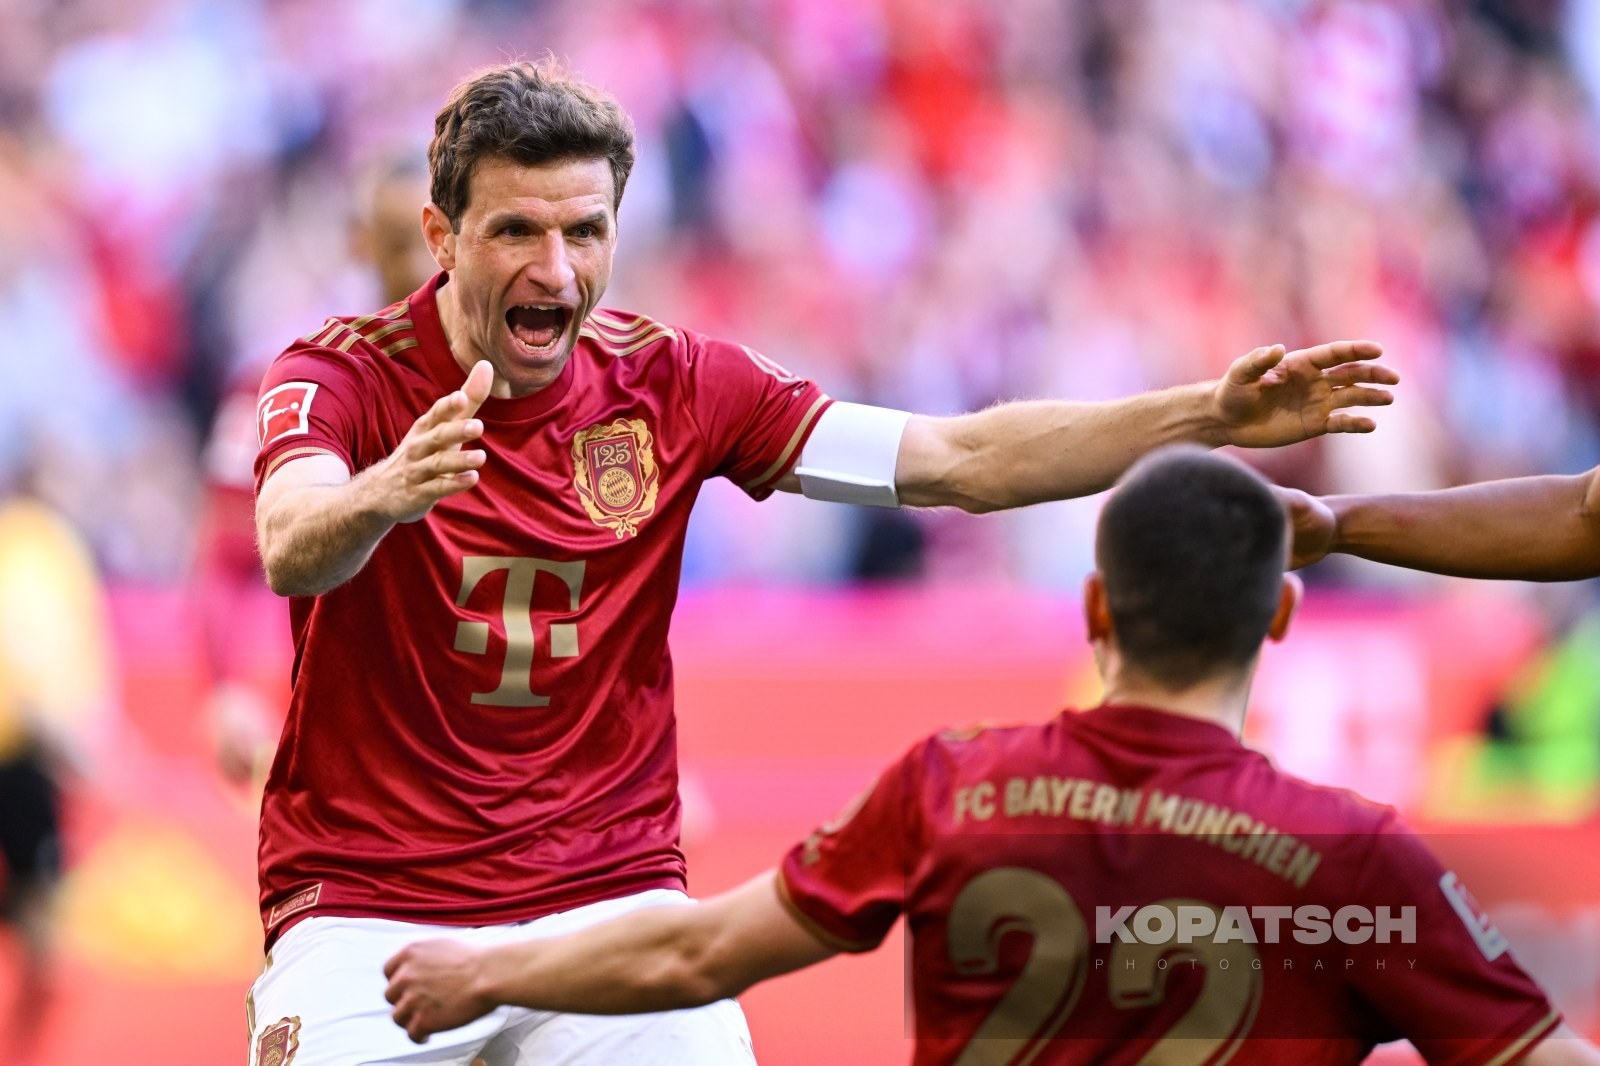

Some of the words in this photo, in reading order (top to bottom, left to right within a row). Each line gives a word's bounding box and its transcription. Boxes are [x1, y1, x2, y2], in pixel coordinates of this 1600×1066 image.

[594, 441, 632, 469] 125
[601, 477, 608, 487] FC
[607, 471, 631, 483] BAYERN
[453, 556, 587, 707] T
[954, 782, 996, 824] FC
[1004, 775, 1143, 827] BAYERN
[1143, 788, 1322, 889] MÜNCHEN
[948, 867, 1264, 1066] 22
